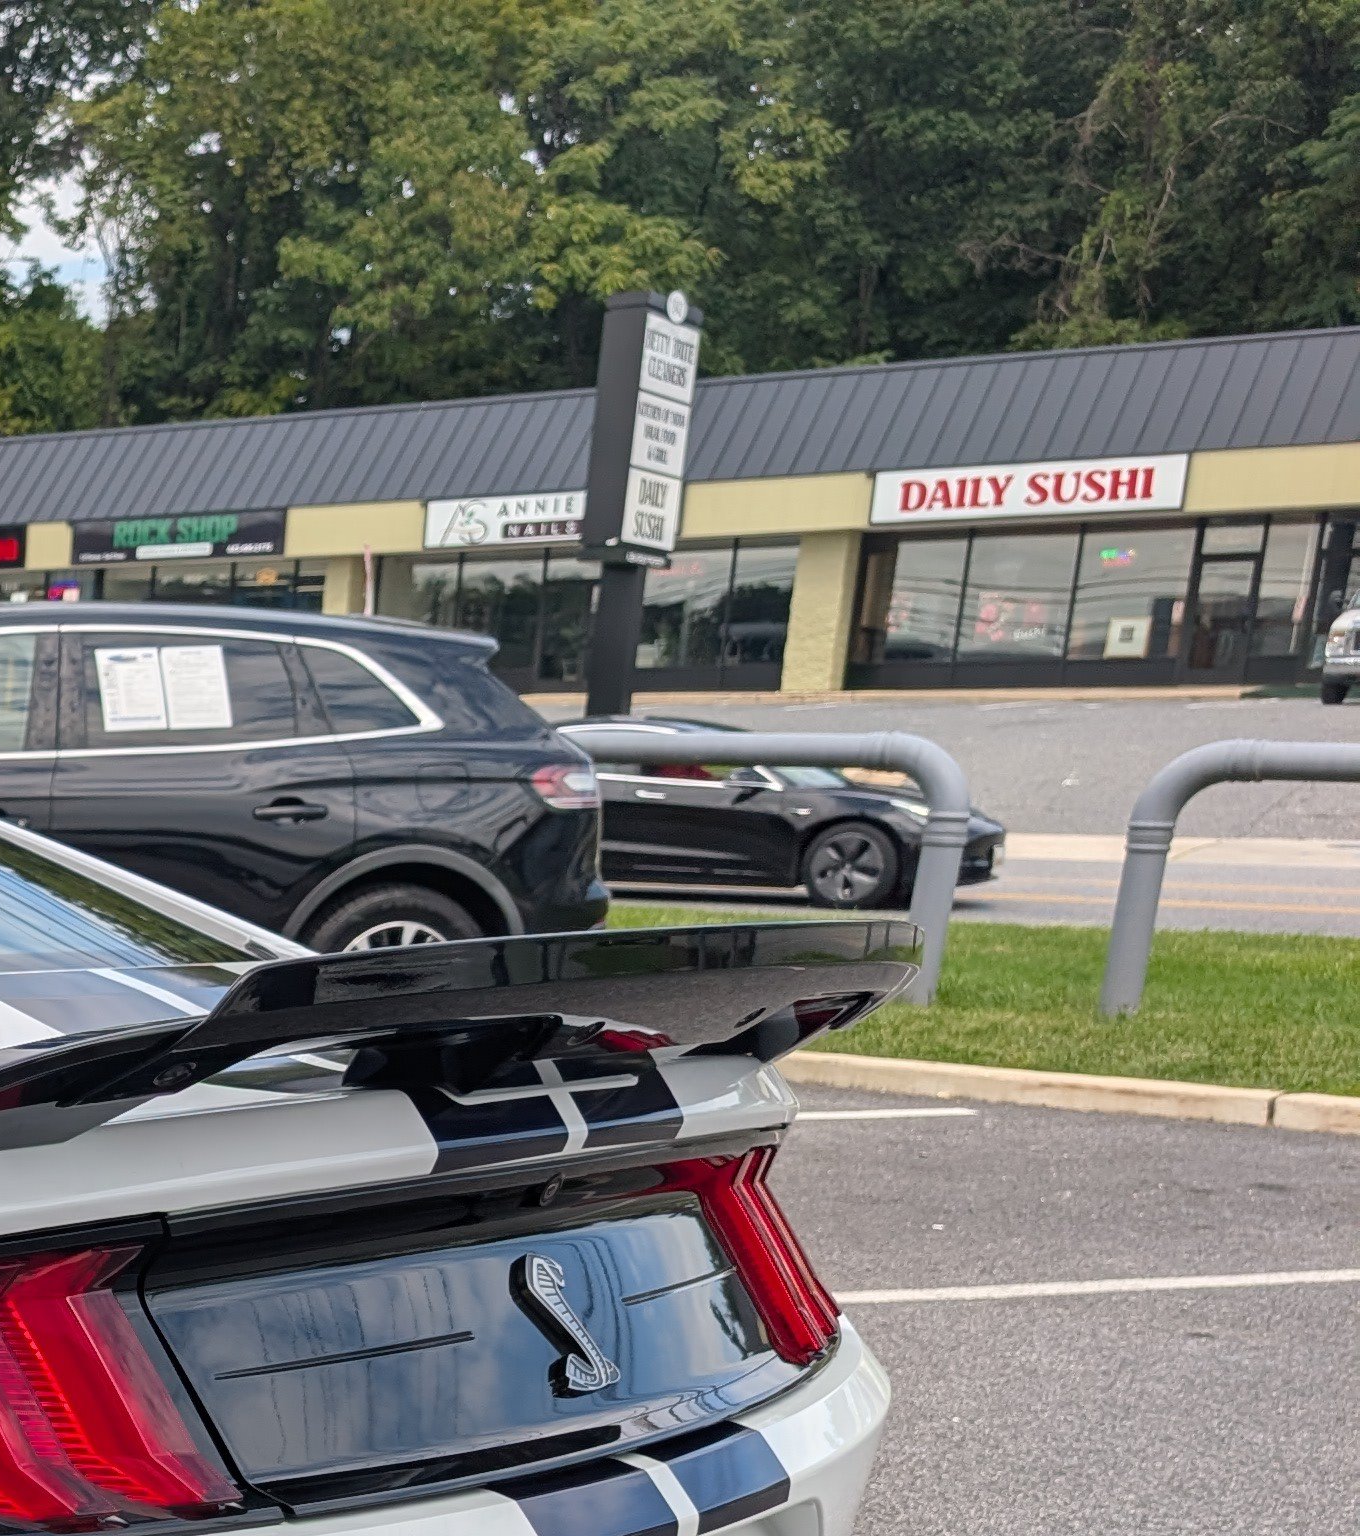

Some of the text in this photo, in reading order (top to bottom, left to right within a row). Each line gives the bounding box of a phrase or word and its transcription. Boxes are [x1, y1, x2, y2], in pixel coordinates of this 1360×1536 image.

[638, 476, 669, 510] DAILY
[898, 466, 1156, 513] DAILY SUSHI
[496, 495, 576, 519] ANNIE
[112, 514, 239, 549] ROCK SHOP
[506, 518, 579, 538] NAILS
[632, 510, 666, 543] SUSHI
